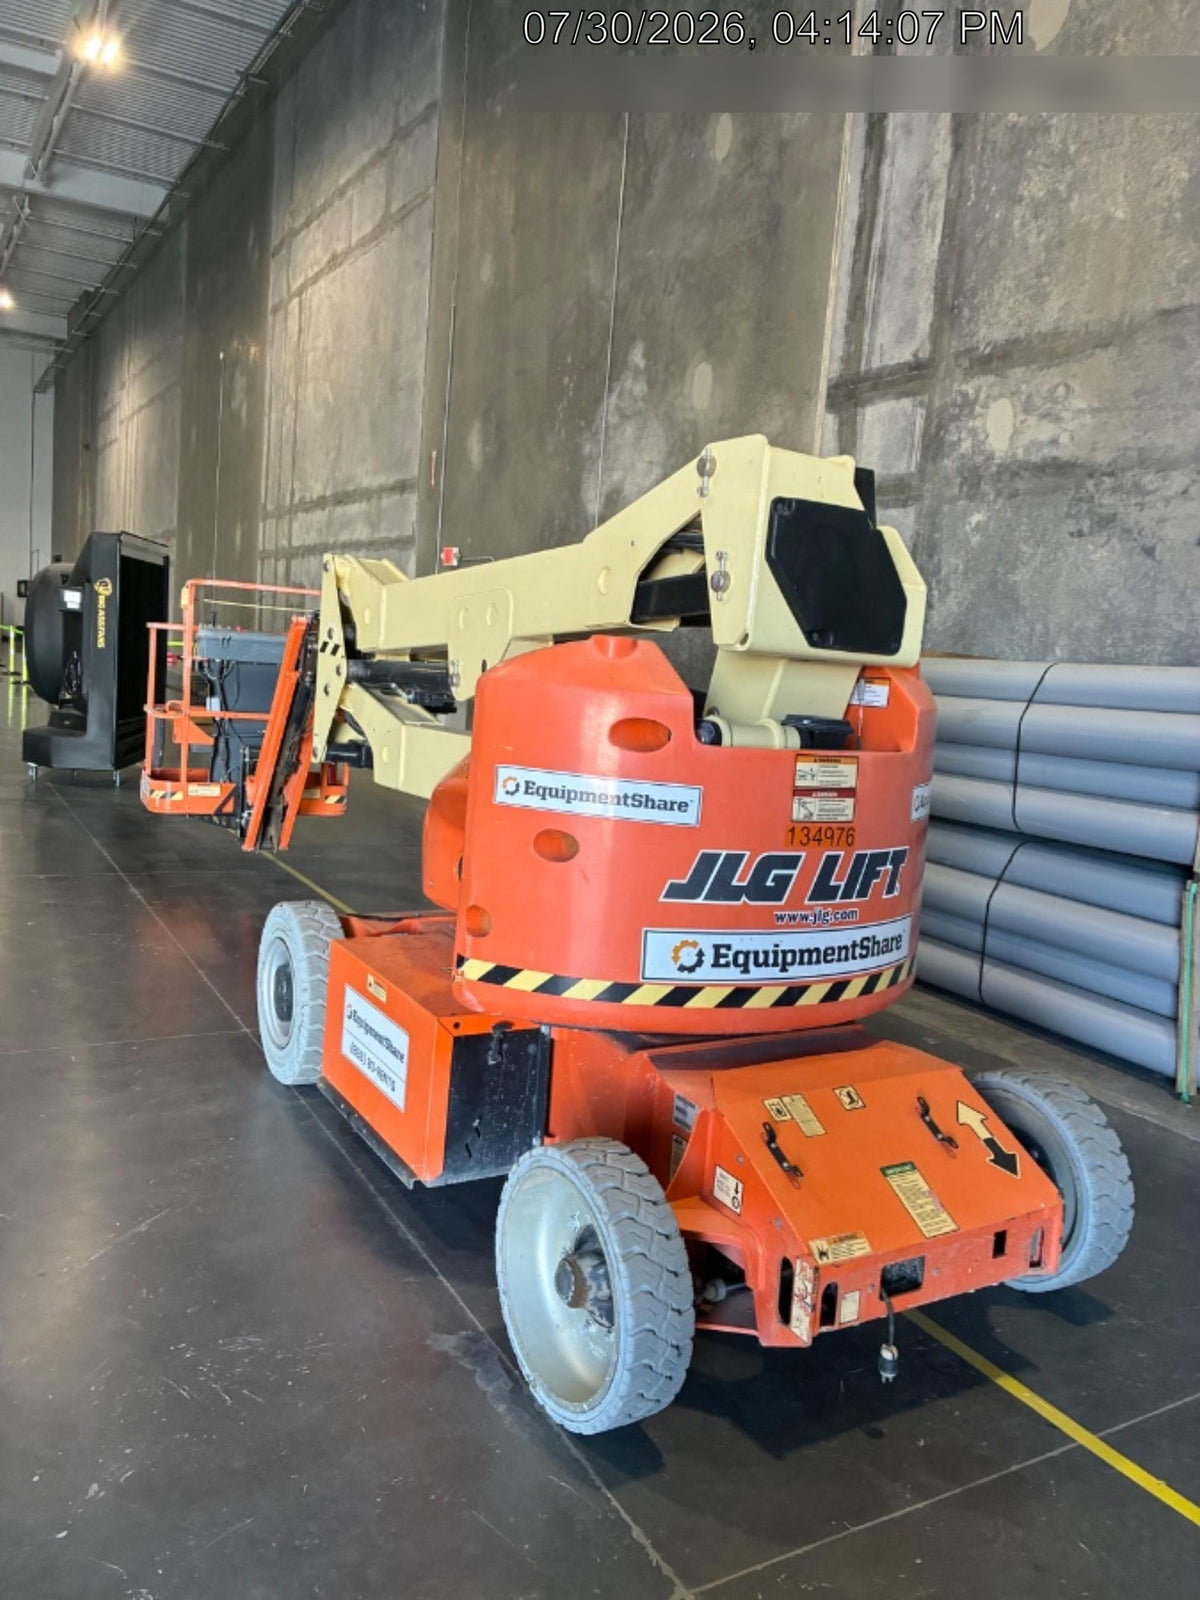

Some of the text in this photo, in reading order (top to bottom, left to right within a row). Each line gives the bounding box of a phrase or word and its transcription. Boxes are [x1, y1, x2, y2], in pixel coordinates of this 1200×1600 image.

[523, 779, 690, 813] EquipmentShare
[787, 825, 856, 847] 134976
[659, 846, 910, 905] JLG LIFT
[774, 907, 858, 924] www.jlg.com
[710, 934, 903, 974] EquipmentShare
